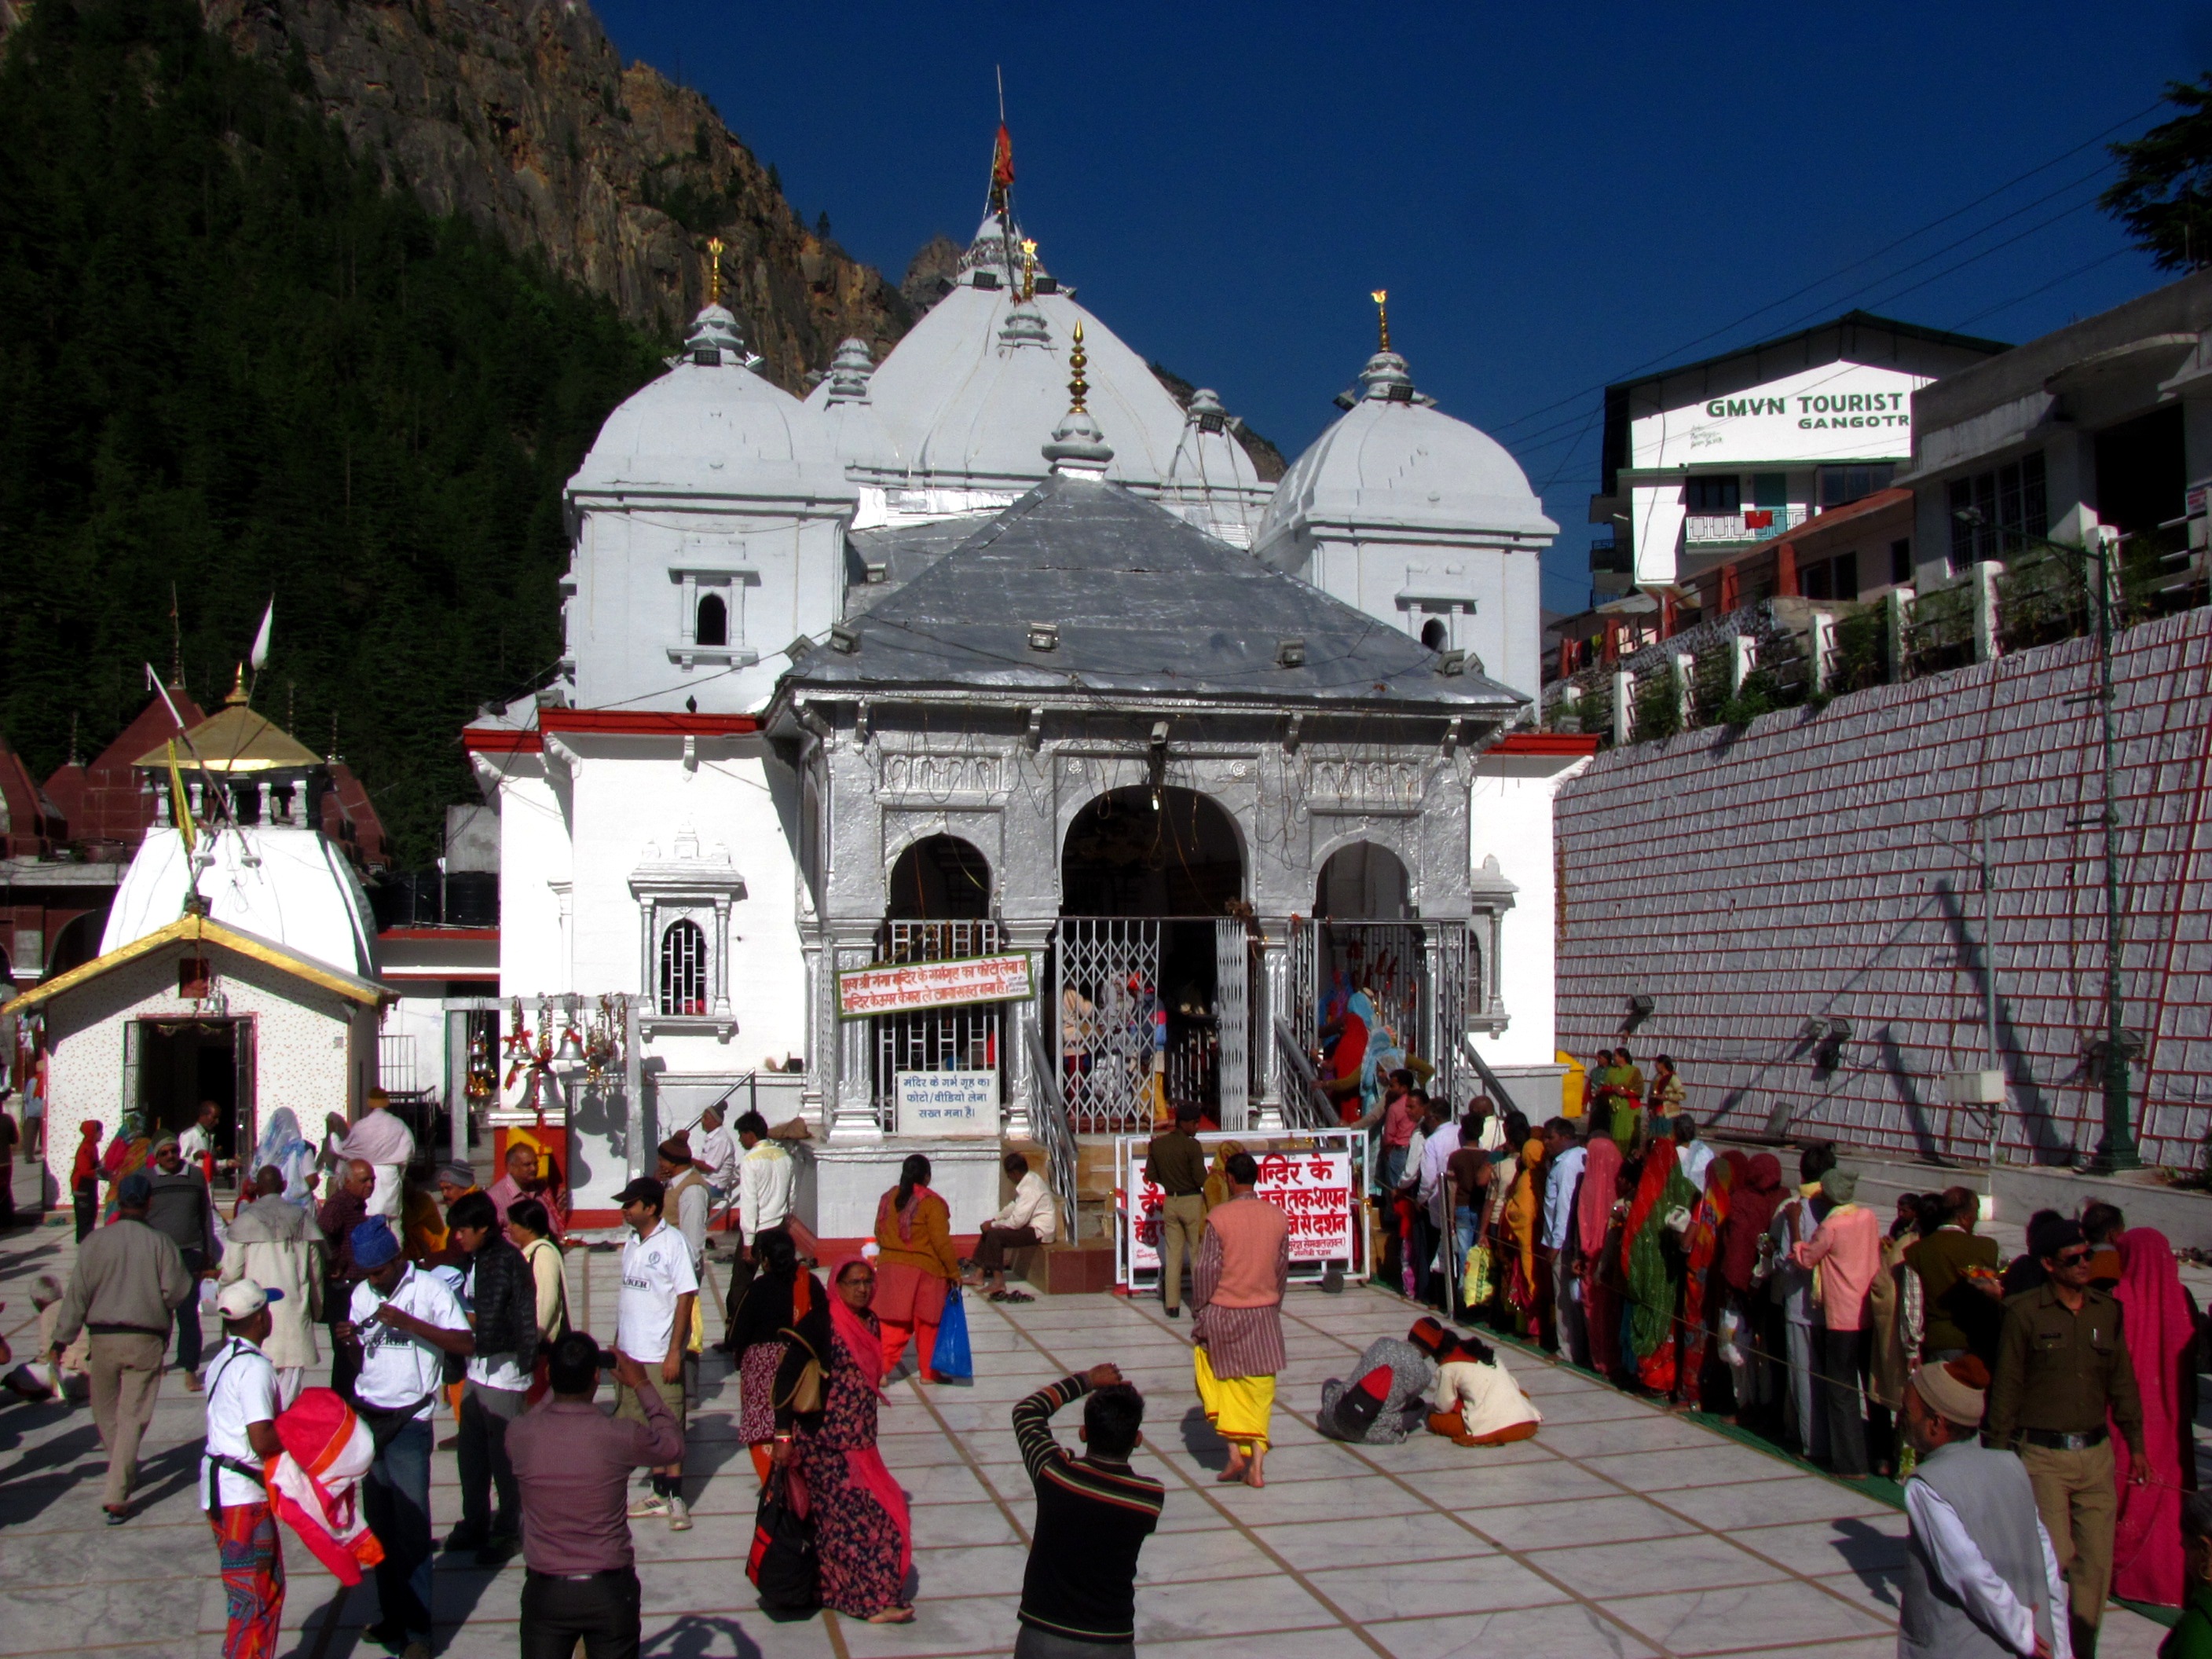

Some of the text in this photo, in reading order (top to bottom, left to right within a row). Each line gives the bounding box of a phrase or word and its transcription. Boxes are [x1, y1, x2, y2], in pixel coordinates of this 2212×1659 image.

[1705, 393, 1903, 418] GMVN TOURIST
[859, 972, 870, 989] श्री
[917, 966, 928, 982] के
[961, 966, 974, 978] का
[977, 959, 999, 976] फोटो
[1000, 958, 1018, 976] लेना
[903, 1075, 990, 1090] मंदिर के गर्भ गृह का
[968, 1090, 987, 1102] लेना
[918, 1108, 942, 1118] सख्त
[944, 1108, 962, 1118] मना
[1306, 1152, 1335, 1181] के
[1287, 1188, 1313, 1212] तक
[1299, 1209, 1312, 1236] से
[1312, 1208, 1348, 1237] दर्शन
